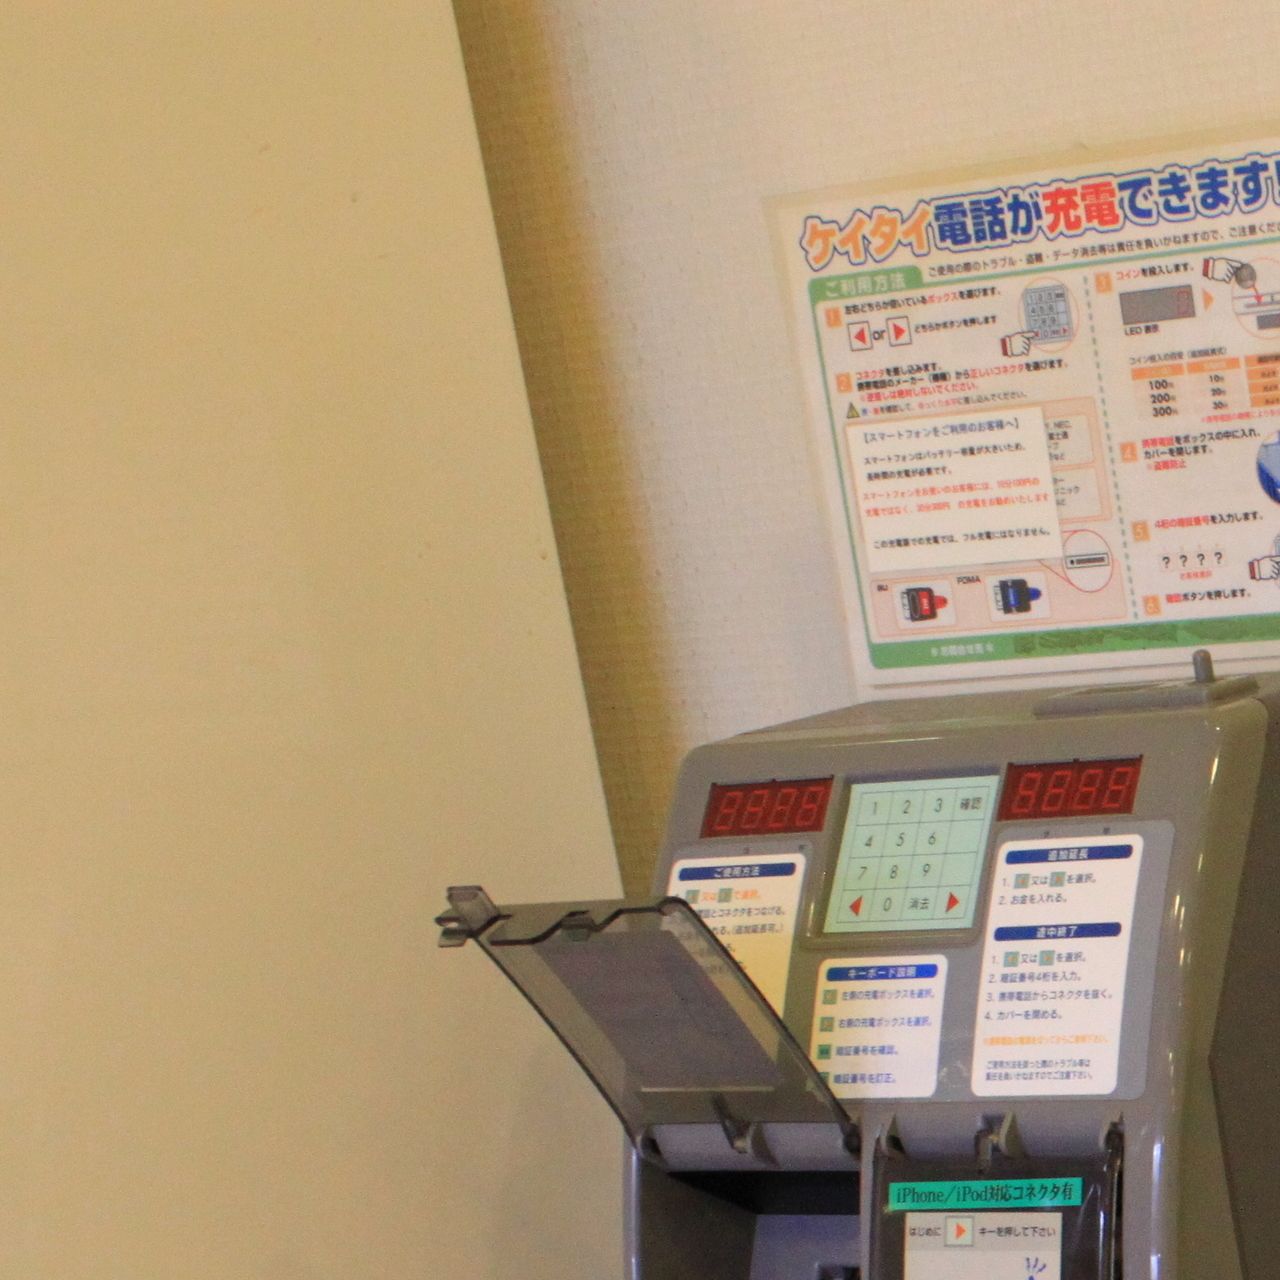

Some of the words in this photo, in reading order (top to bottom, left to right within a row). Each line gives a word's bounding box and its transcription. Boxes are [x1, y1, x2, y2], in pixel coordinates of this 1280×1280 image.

[825, 274, 906, 298] ご利用方法
[872, 329, 886, 341] or
[903, 800, 912, 815] 2
[934, 798, 943, 813] 3
[896, 832, 905, 847] 5
[928, 832, 936, 846] 6
[857, 866, 868, 881] 7
[890, 864, 898, 880] 8
[922, 863, 932, 877] 9
[883, 897, 892, 912] 0
[909, 1226, 942, 1237] はじめに
[978, 1225, 1056, 1238] キーを押して下さい
